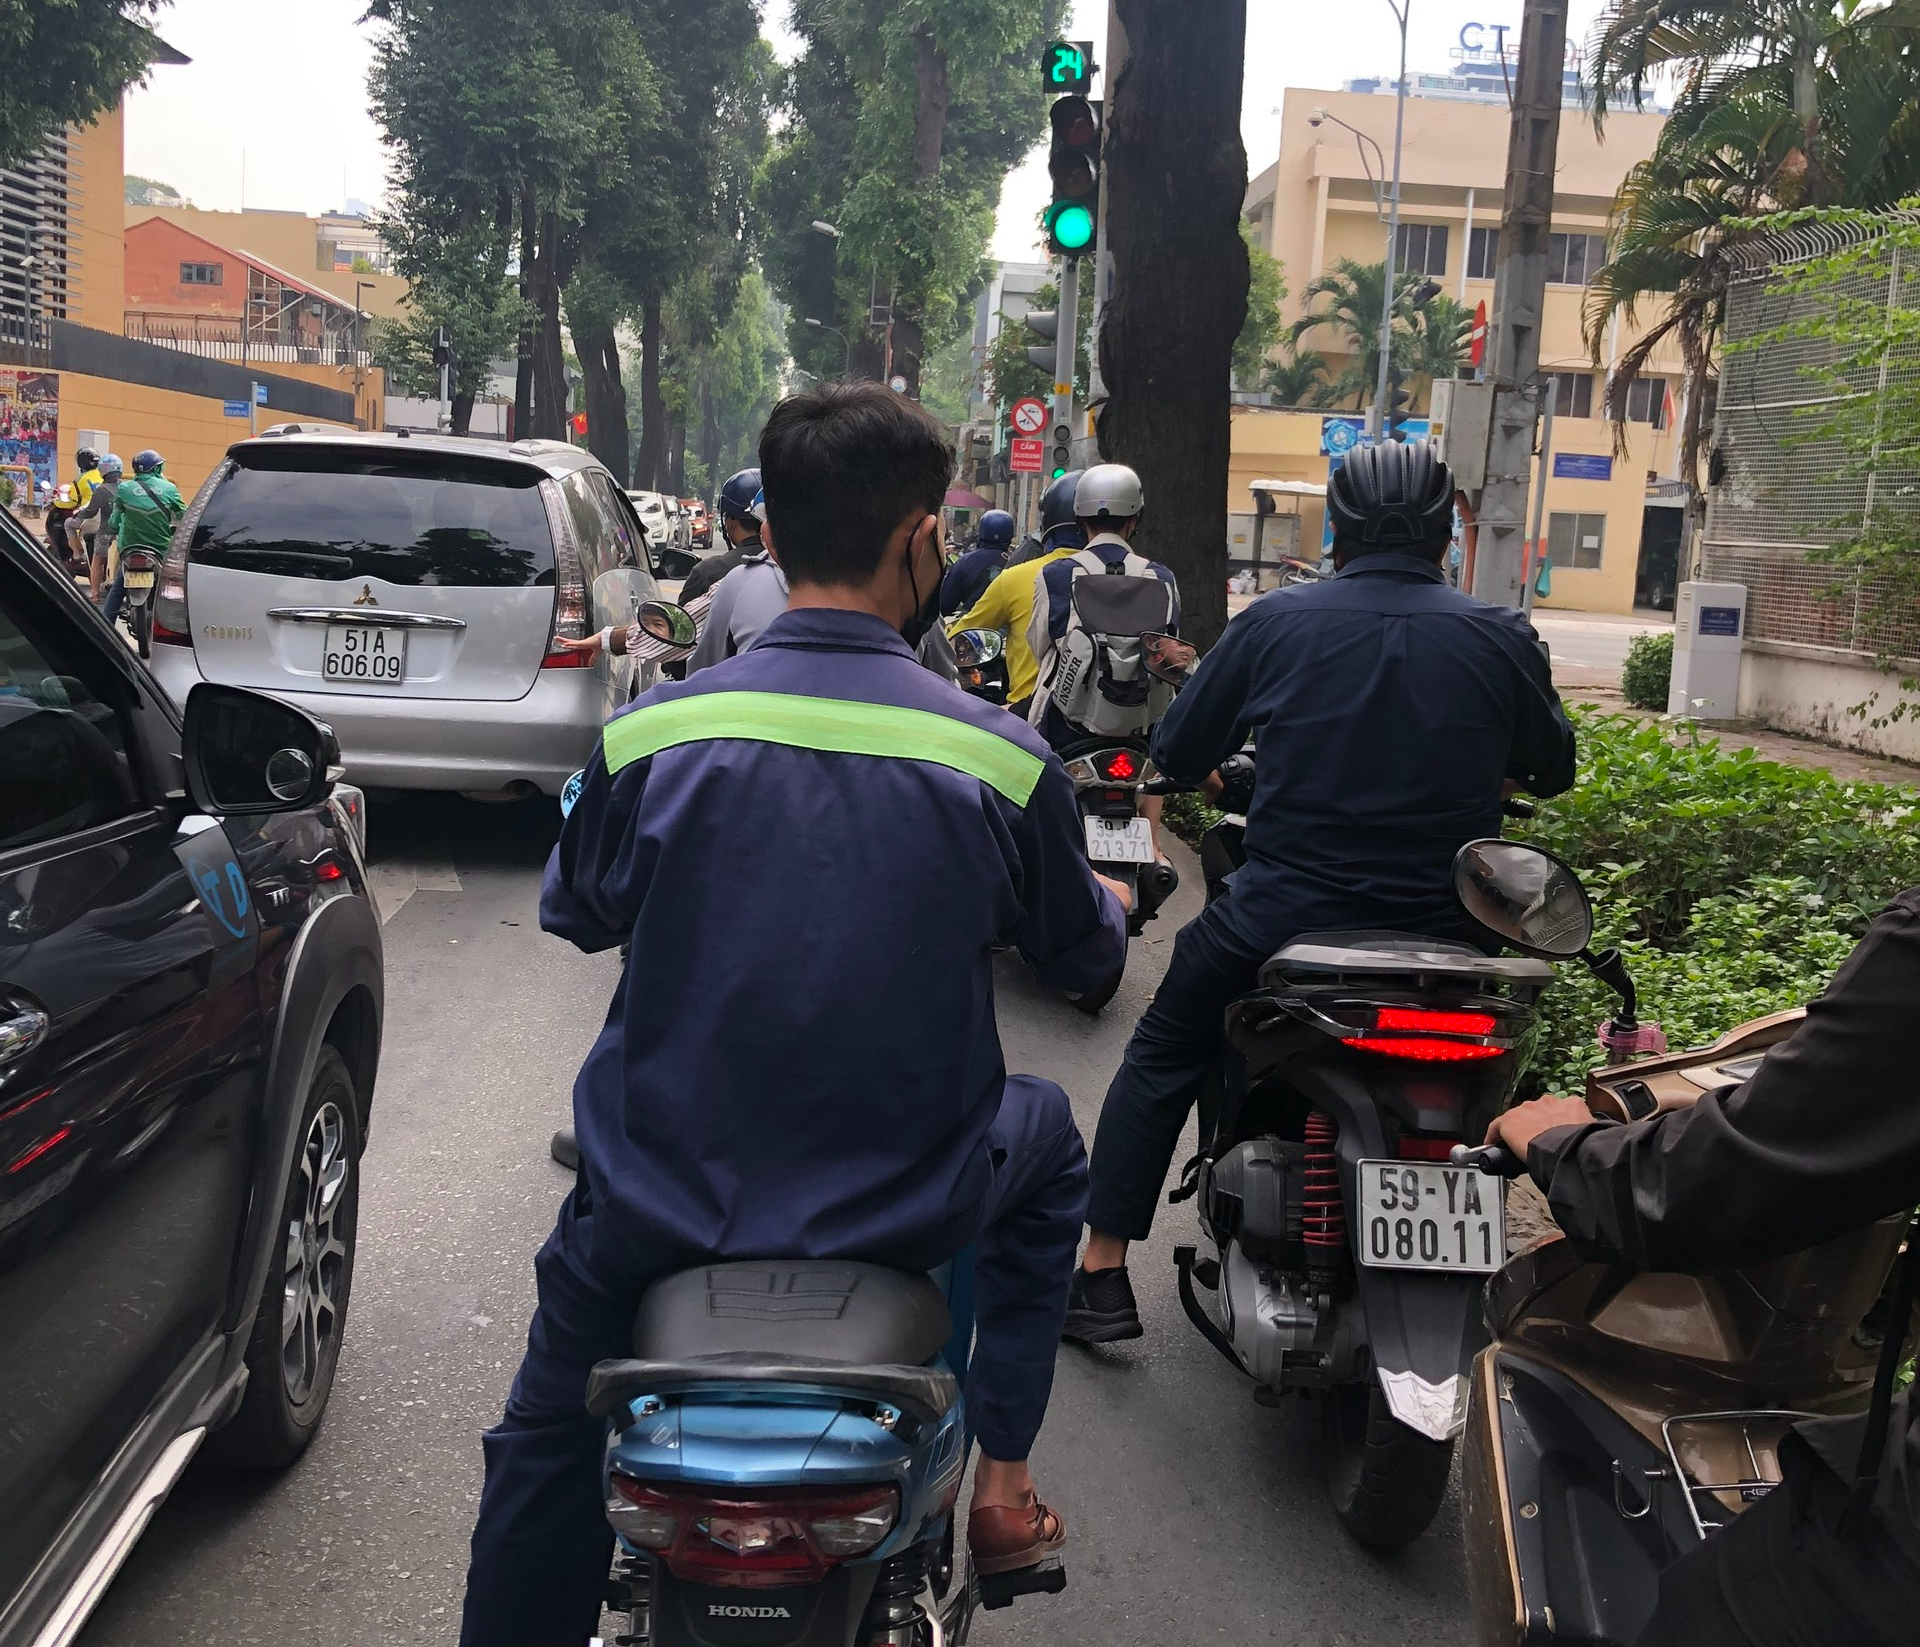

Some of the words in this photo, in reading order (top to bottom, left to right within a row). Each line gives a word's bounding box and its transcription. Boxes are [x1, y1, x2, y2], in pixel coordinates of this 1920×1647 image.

[1459, 22, 1510, 54] CT
[1052, 49, 1083, 82] 24
[345, 629, 386, 654] 51A
[326, 652, 401, 679] 606.09
[1059, 656, 1083, 707] INSIDER
[1091, 839, 1148, 860] 213.71
[1379, 1167, 1482, 1216] 59-YA
[1370, 1216, 1491, 1265] 080.11
[708, 1604, 791, 1618] HONDA
